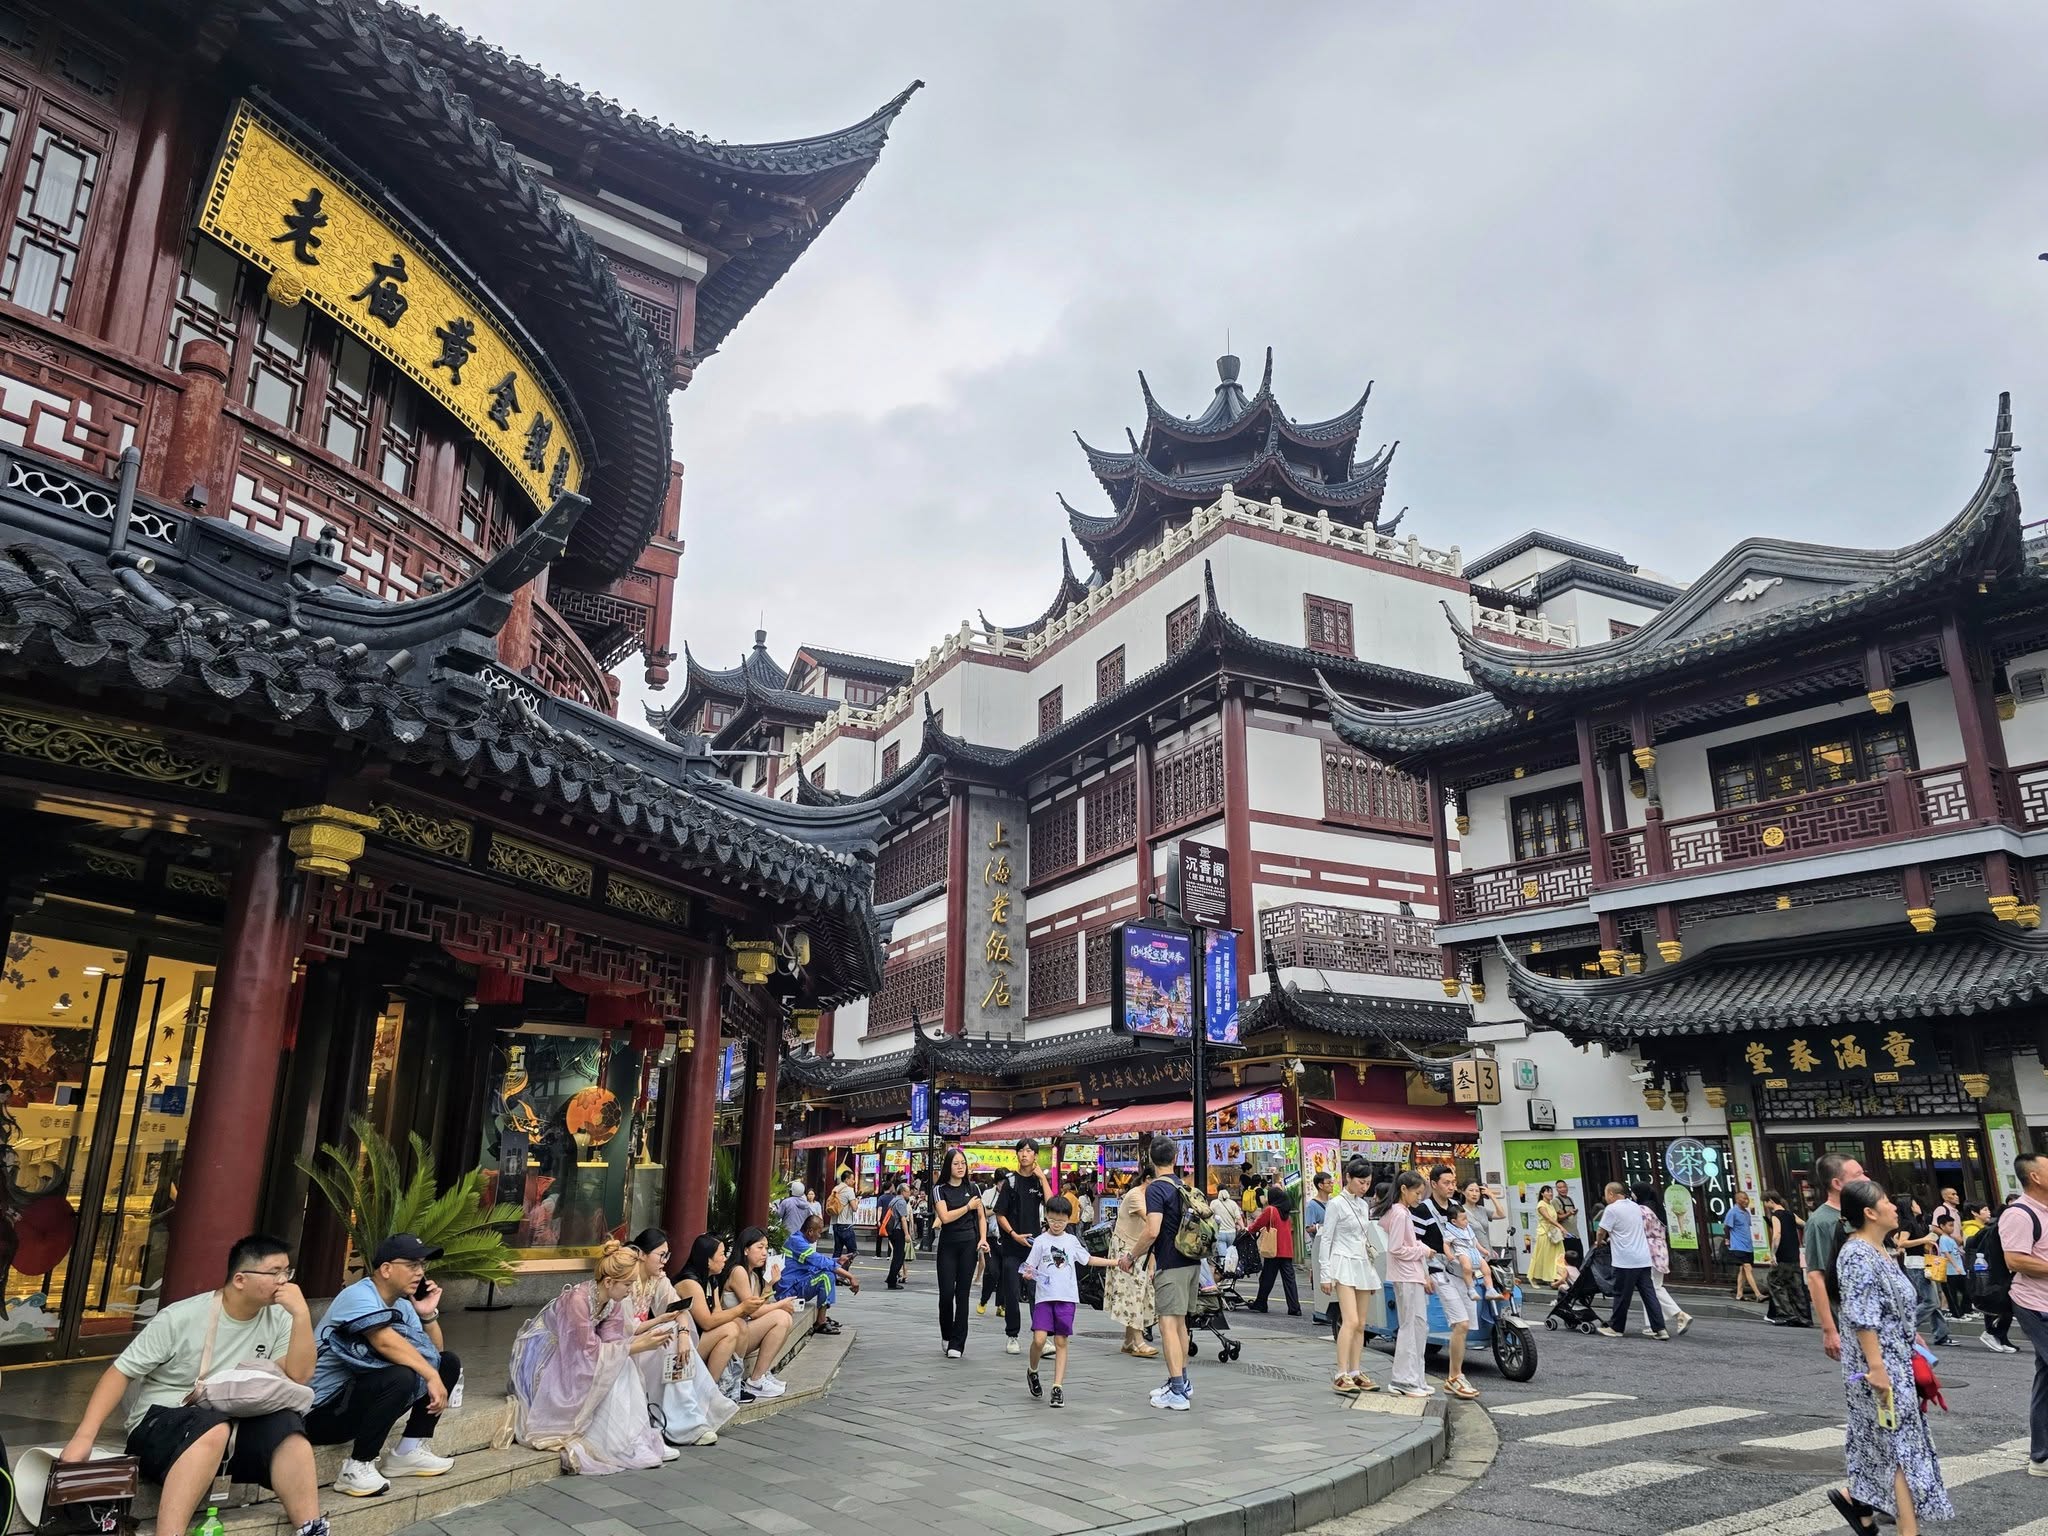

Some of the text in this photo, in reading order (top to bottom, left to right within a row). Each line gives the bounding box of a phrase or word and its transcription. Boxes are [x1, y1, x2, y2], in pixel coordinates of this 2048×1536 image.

[1185, 855, 1225, 878] 沉香阁
[1744, 1030, 1917, 1076] 童涵春堂
[1483, 1067, 1494, 1090] 3
[53, 1117, 71, 1129] 老庙
[151, 1121, 167, 1133] 老庙
[1674, 1145, 1704, 1176] 茶
